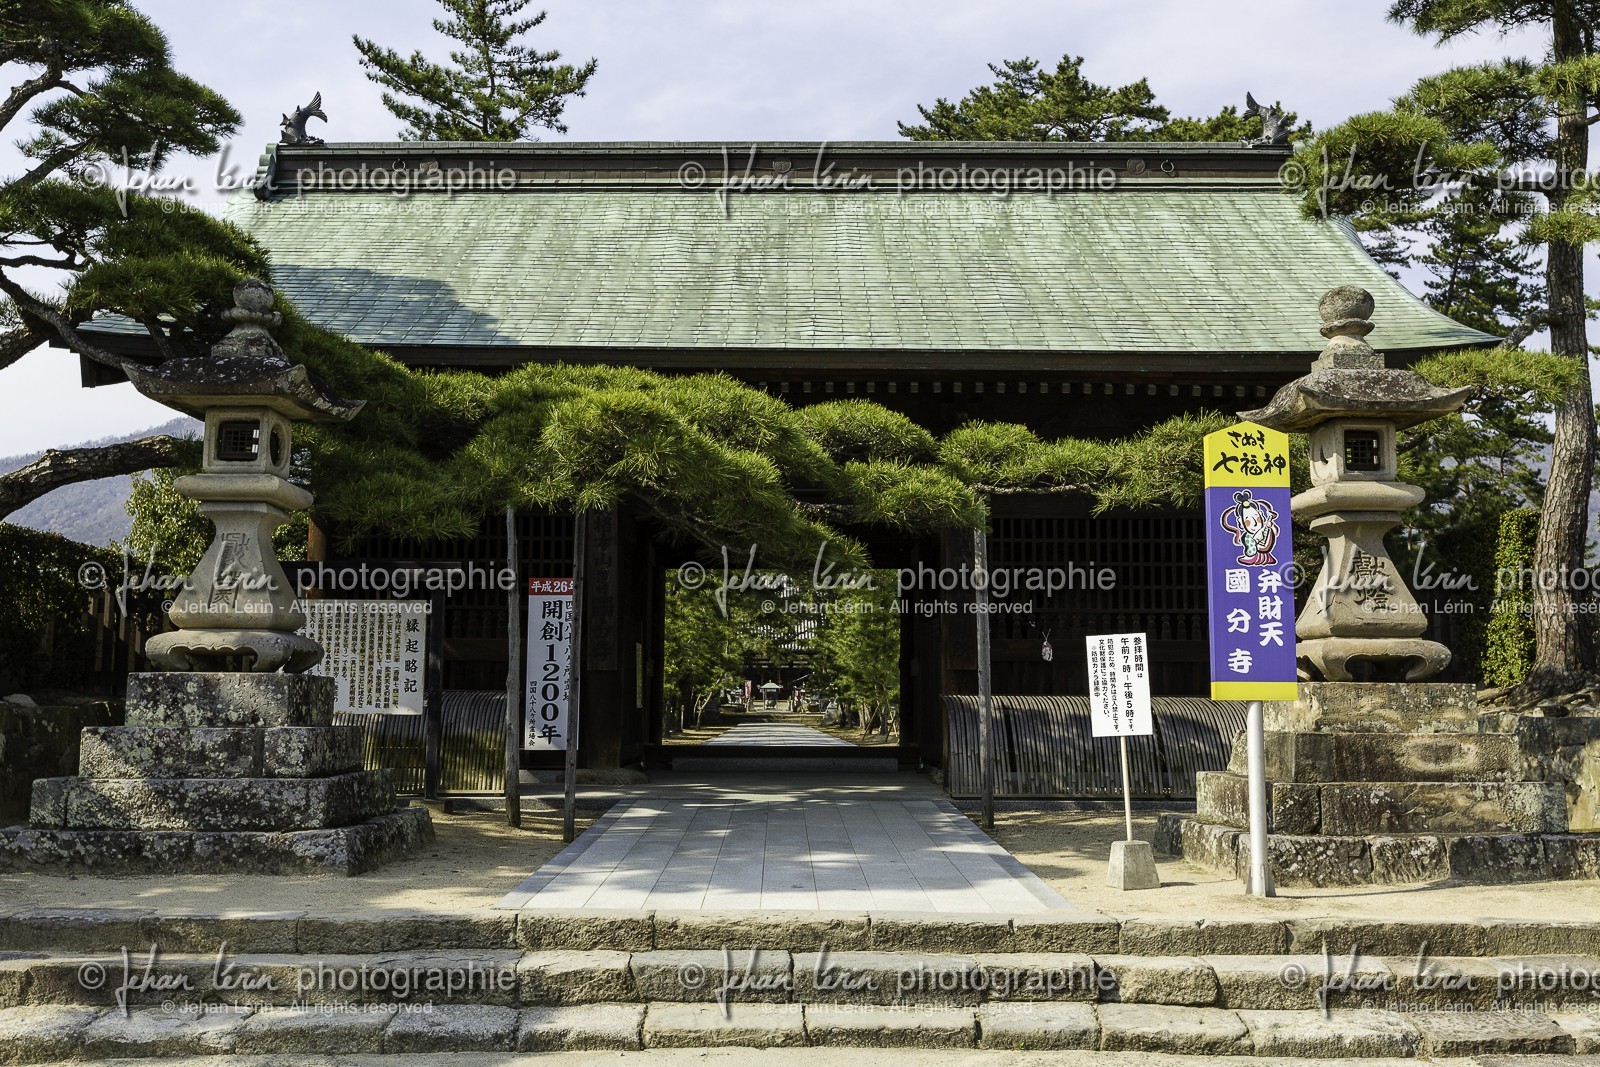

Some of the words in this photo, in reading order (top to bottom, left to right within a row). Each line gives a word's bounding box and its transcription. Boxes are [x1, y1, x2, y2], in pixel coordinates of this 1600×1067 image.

[1212, 452, 1286, 476] 七福神
[1227, 430, 1266, 448] さぬき
[1225, 568, 1253, 674] 國分寺
[1258, 569, 1284, 647] 弁財天
[404, 618, 420, 693] 縁起略記
[538, 600, 564, 745] 開創1200年
[1134, 637, 1144, 678] 参拝時間は
